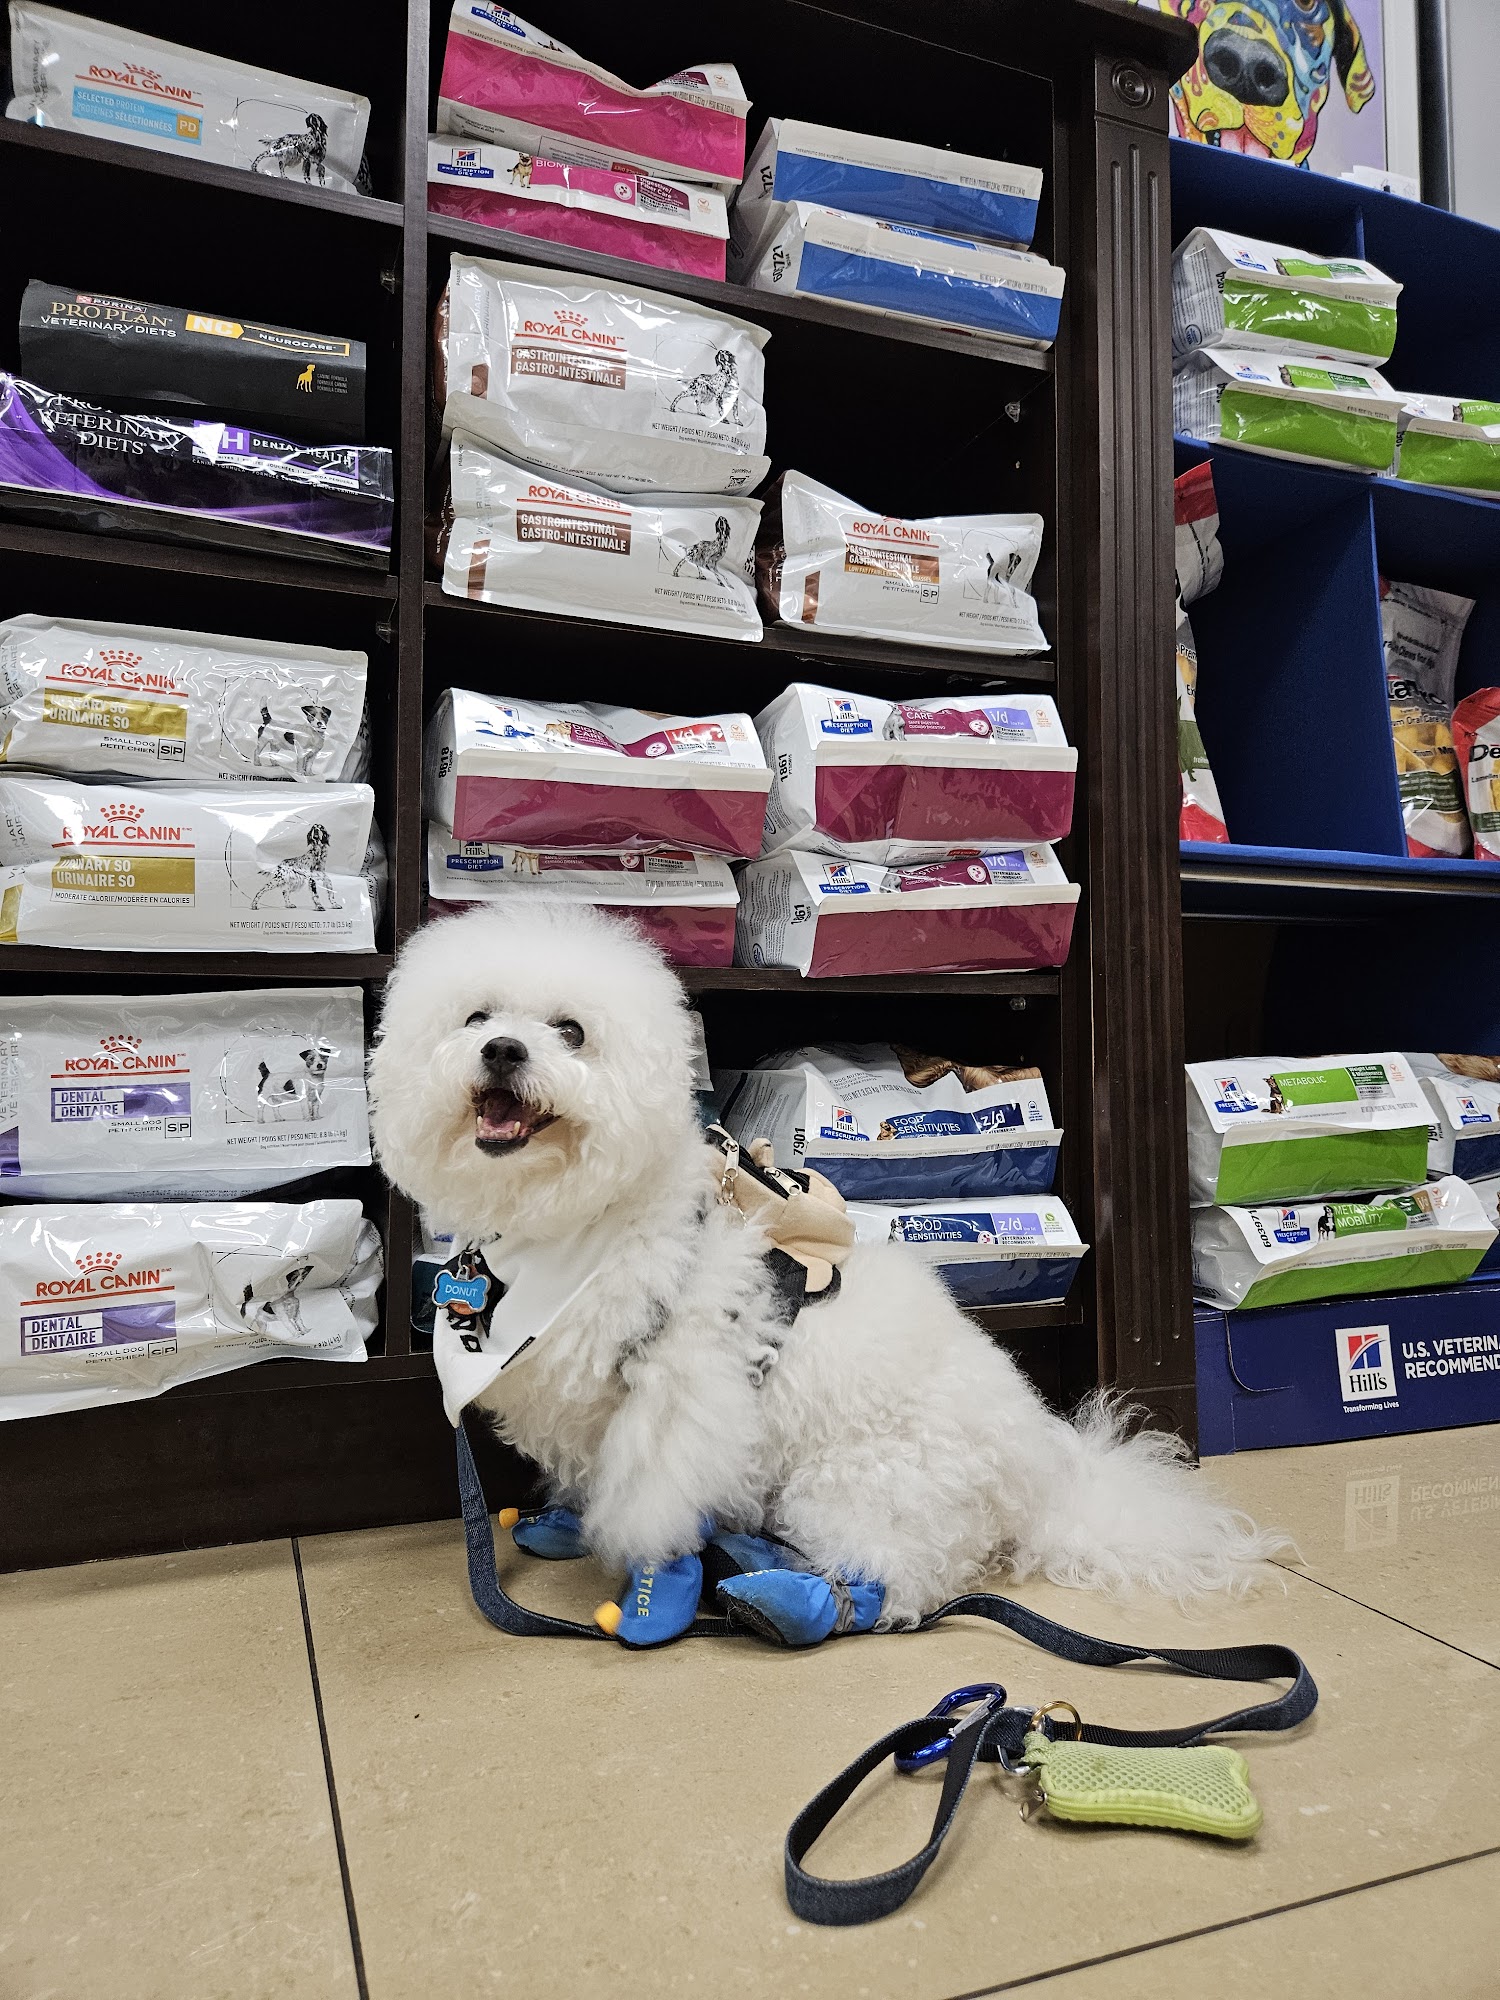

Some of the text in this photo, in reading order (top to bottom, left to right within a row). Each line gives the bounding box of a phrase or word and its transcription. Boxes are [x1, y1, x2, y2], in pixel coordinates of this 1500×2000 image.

[89, 65, 192, 100] ROYAL CANIN
[77, 91, 145, 113] SELECTED PROTEIN
[115, 110, 173, 132] SÉLECTIONNÉES
[178, 120, 196, 133] PD
[441, 166, 490, 175] PRESCRIPTION
[456, 160, 477, 168] Hill's
[93, 299, 146, 313] PURINA
[50, 302, 169, 328] PRO PLAN
[41, 315, 177, 338] VETERINARY DIETS
[193, 315, 234, 336] NC
[524, 320, 616, 346] ROYAL CANIN
[259, 333, 336, 351] NEUROCARE
[515, 361, 622, 386] GASTRO-INTESTINALE
[78, 430, 144, 455] DIETS
[529, 485, 573, 502] ROYAL
[521, 513, 618, 536] GASTROINTESTINAL
[853, 521, 931, 542] ROYAL CANIN
[521, 527, 627, 552] GASTRO-INTESTINALE
[882, 585, 920, 595] PETIT CHIEN
[61, 663, 176, 690] ROYAL CANIN
[49, 707, 130, 730] URINAIRE SO
[907, 711, 934, 720] CARE
[825, 720, 869, 729] PRESCRIPTION
[100, 742, 156, 754] PETIT CHIEN
[103, 736, 133, 746] SMALL
[63, 825, 181, 841] RYAL CANIN
[465, 847, 486, 856] Hill's
[114, 859, 131, 872] SO
[648, 857, 684, 866] VETERINARIAN
[56, 871, 136, 888] URINAIRE SO
[822, 884, 866, 892] PRESCRIPTION
[55, 892, 88, 901] MODERATE
[159, 896, 190, 904] CALORIES
[230, 921, 240, 929] NET
[240, 921, 261, 929] WEIGHT
[281, 921, 291, 929] NET
[294, 921, 307, 929] PESO
[65, 1054, 176, 1072] ROYAL CANIN
[1279, 1075, 1328, 1088] METABOLIC
[61, 1090, 107, 1103] DENTAL
[61, 1103, 119, 1118] DENTAIRE
[893, 1115, 925, 1127] FOOD
[980, 1110, 1006, 1127] z/d
[836, 1122, 855, 1132] Hill's
[898, 1123, 961, 1134] SENSITIVITIES
[226, 1138, 237, 1146] NET
[238, 1136, 258, 1145] WEIGHT
[261, 1135, 277, 1143] POIDS
[277, 1134, 287, 1142] NET
[290, 1133, 304, 1141] PESO
[793, 1127, 806, 1156] 7901
[824, 1129, 867, 1141] PRESCRIPTION
[906, 1218, 942, 1232] FOOD
[998, 1217, 1023, 1231] z/d
[1282, 1220, 1300, 1230] Hill's
[1336, 1213, 1384, 1229] MOBILITY
[908, 1231, 962, 1241] SENSITIVITIES
[1249, 1209, 1272, 1249] 603971
[1276, 1230, 1308, 1239] PRESCRIPTION
[36, 1269, 160, 1297] ROYAL CANIN
[444, 1284, 478, 1298] DONUT
[31, 1316, 83, 1334] DENTAL
[31, 1330, 96, 1351] DENTAIRE
[88, 1350, 120, 1358] SMALL
[1401, 1340, 1431, 1360] U.S.
[114, 1353, 145, 1362] CHIEN
[1348, 1372, 1388, 1393] Hill's
[1342, 1400, 1400, 1414] Transforming Lives
